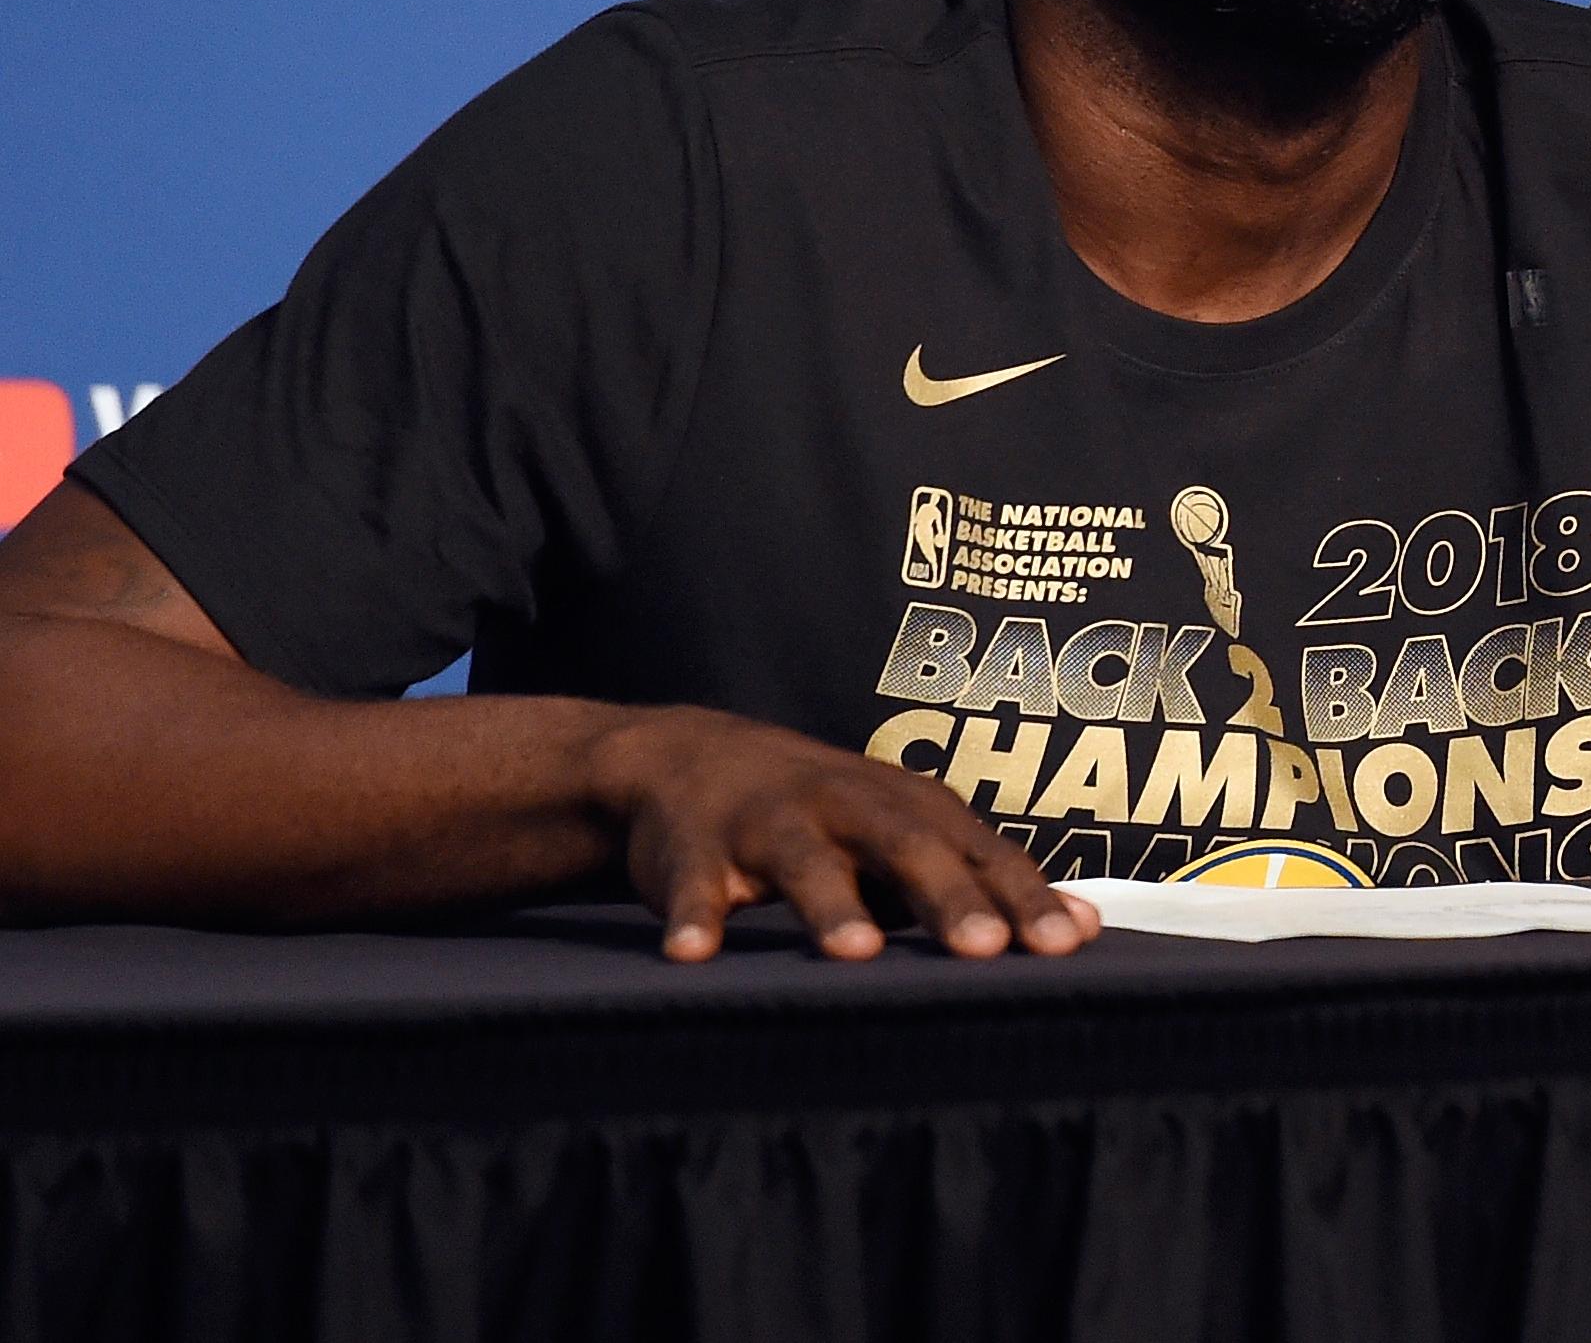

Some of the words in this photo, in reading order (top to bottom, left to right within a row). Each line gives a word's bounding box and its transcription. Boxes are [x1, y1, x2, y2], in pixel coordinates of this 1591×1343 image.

[957, 495, 993, 523] THE
[1000, 504, 1147, 530] NATIONAL
[955, 520, 1116, 553] BASKETBALL
[952, 546, 1132, 580] ASSOCIATION
[950, 570, 1088, 604] PRESENTS:
[875, 601, 1216, 725] BACK
[1225, 643, 1284, 737] 2
